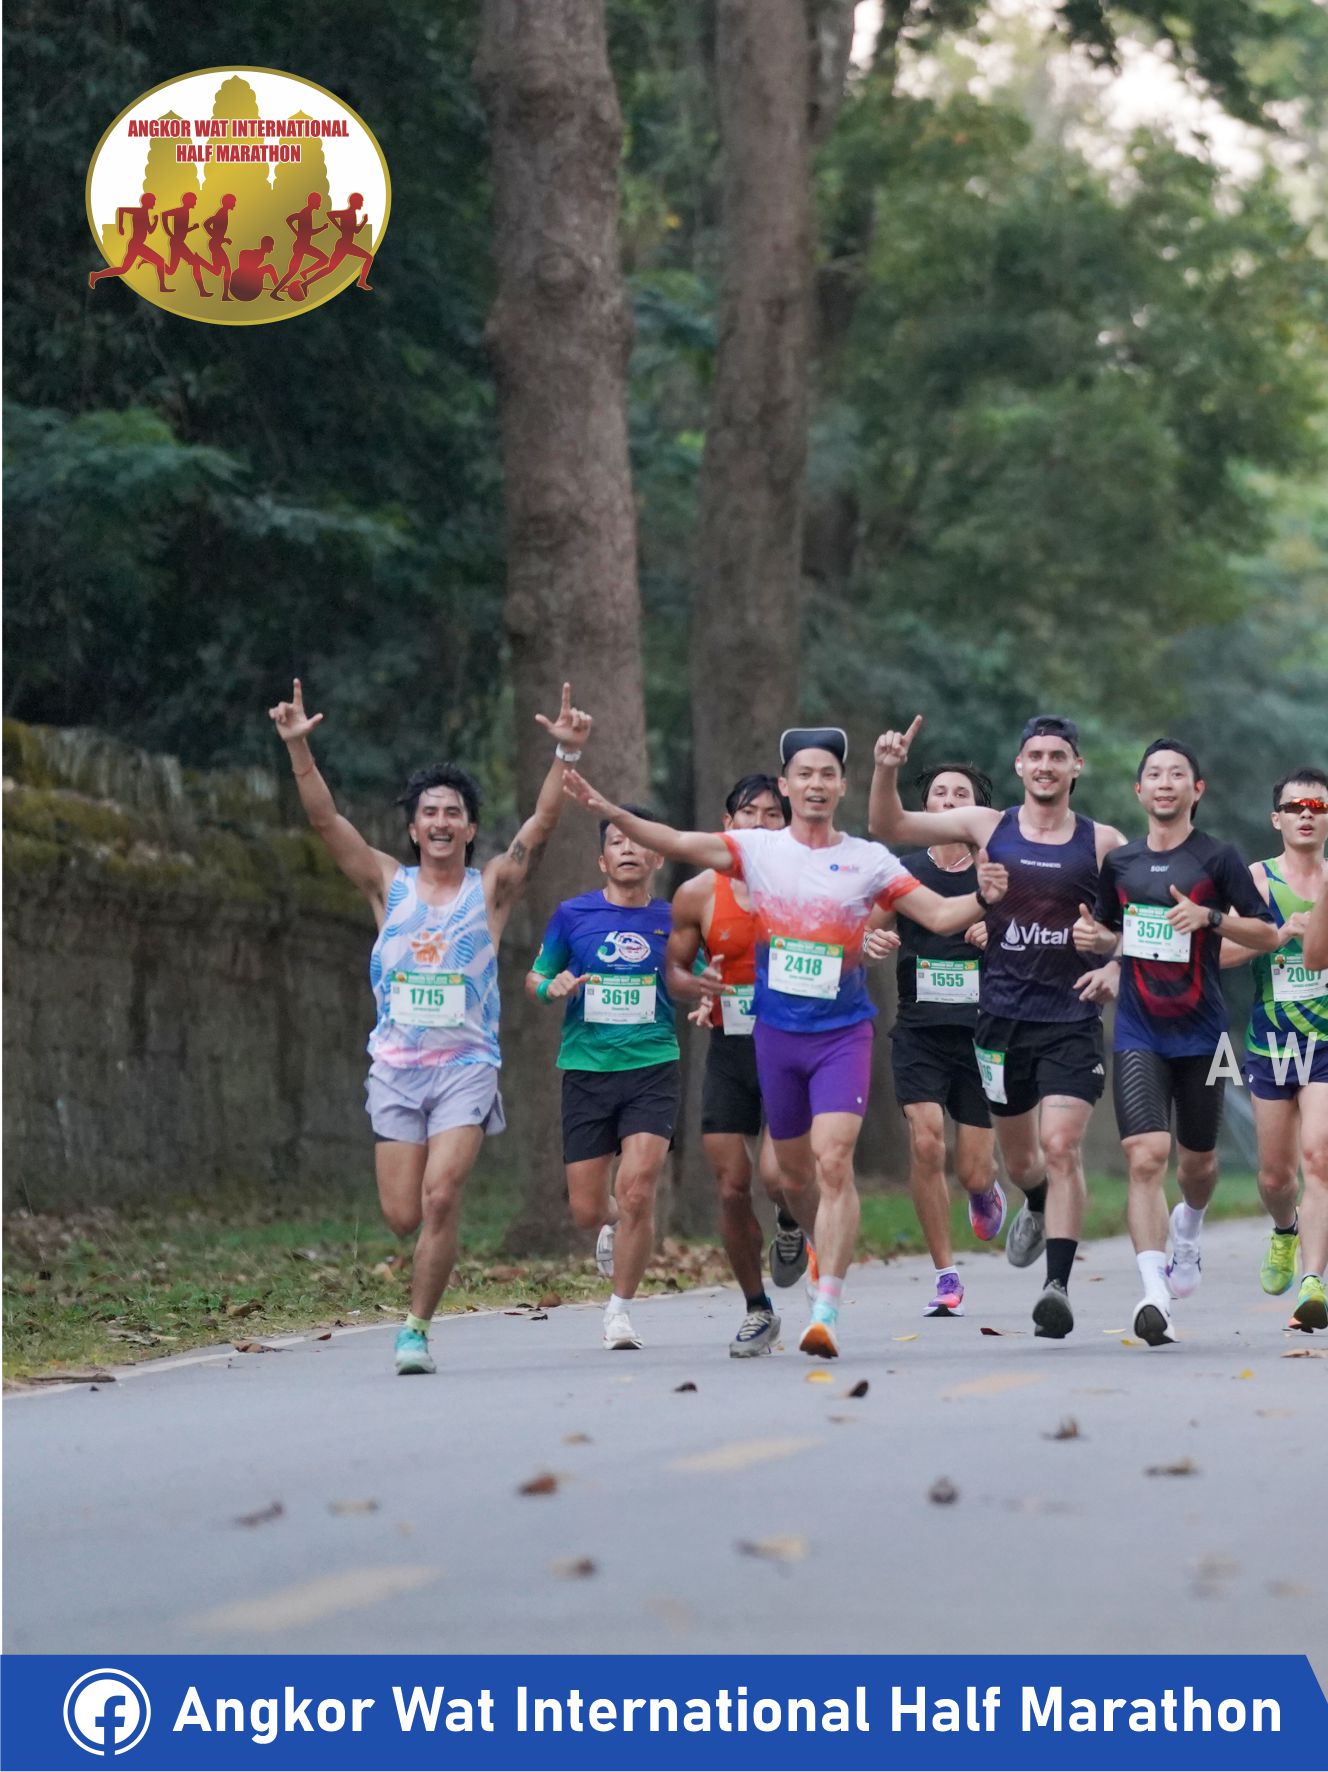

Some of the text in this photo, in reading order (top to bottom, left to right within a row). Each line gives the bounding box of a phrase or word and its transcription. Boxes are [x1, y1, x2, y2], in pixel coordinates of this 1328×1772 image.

[1019, 922, 1069, 945] Vital
[1137, 920, 1173, 940] 3570
[784, 954, 822, 976] 2418
[930, 972, 964, 987] 1555
[410, 988, 444, 1006] 1715
[601, 988, 640, 1005] 3619
